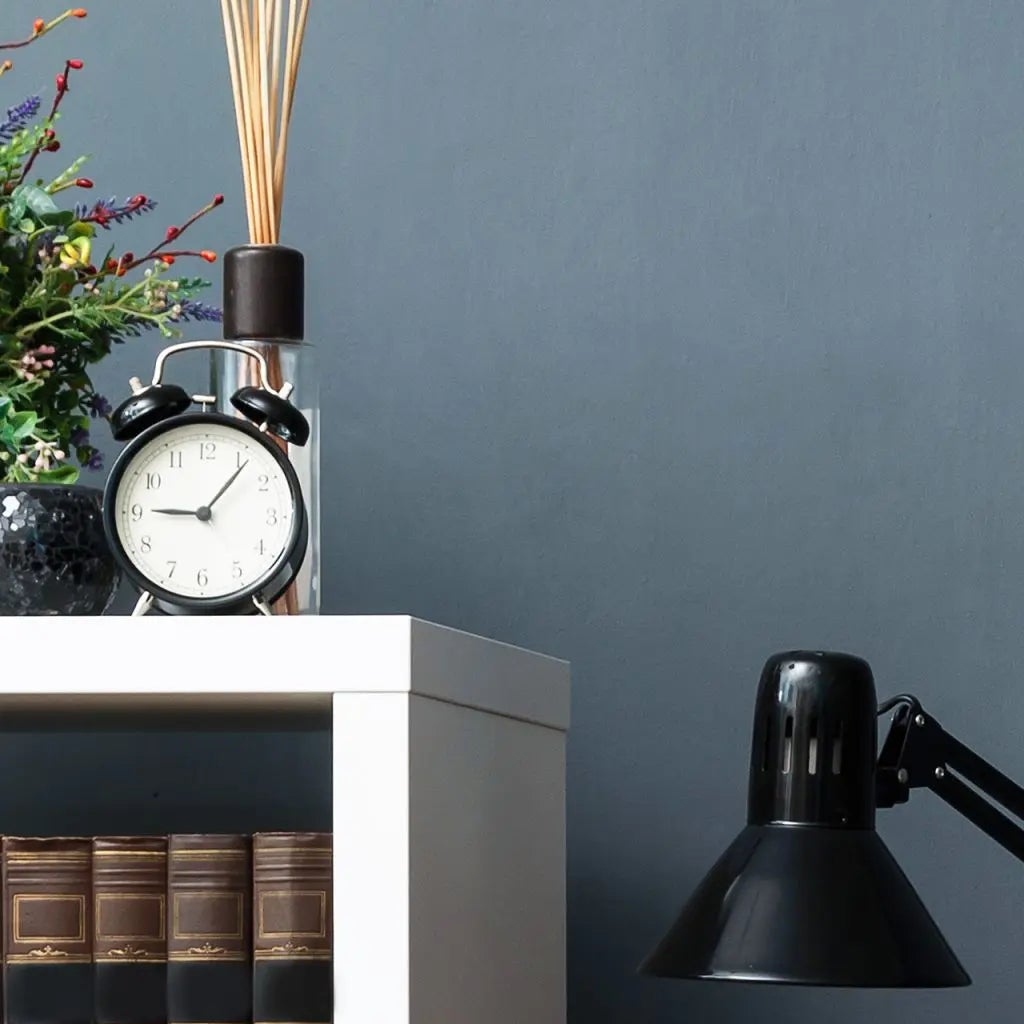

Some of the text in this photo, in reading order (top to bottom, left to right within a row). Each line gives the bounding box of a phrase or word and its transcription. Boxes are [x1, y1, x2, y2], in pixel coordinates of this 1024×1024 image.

[169, 451, 183, 468] 11
[200, 443, 216, 460] 12
[235, 451, 241, 469] 1
[146, 472, 162, 490] 10
[258, 474, 269, 492] 2
[131, 504, 143, 522] 9
[266, 508, 277, 526] 3
[140, 536, 152, 553] 8
[253, 538, 267, 556] 4
[166, 561, 177, 579] 7
[197, 569, 208, 587] 6
[232, 561, 243, 578] 5
